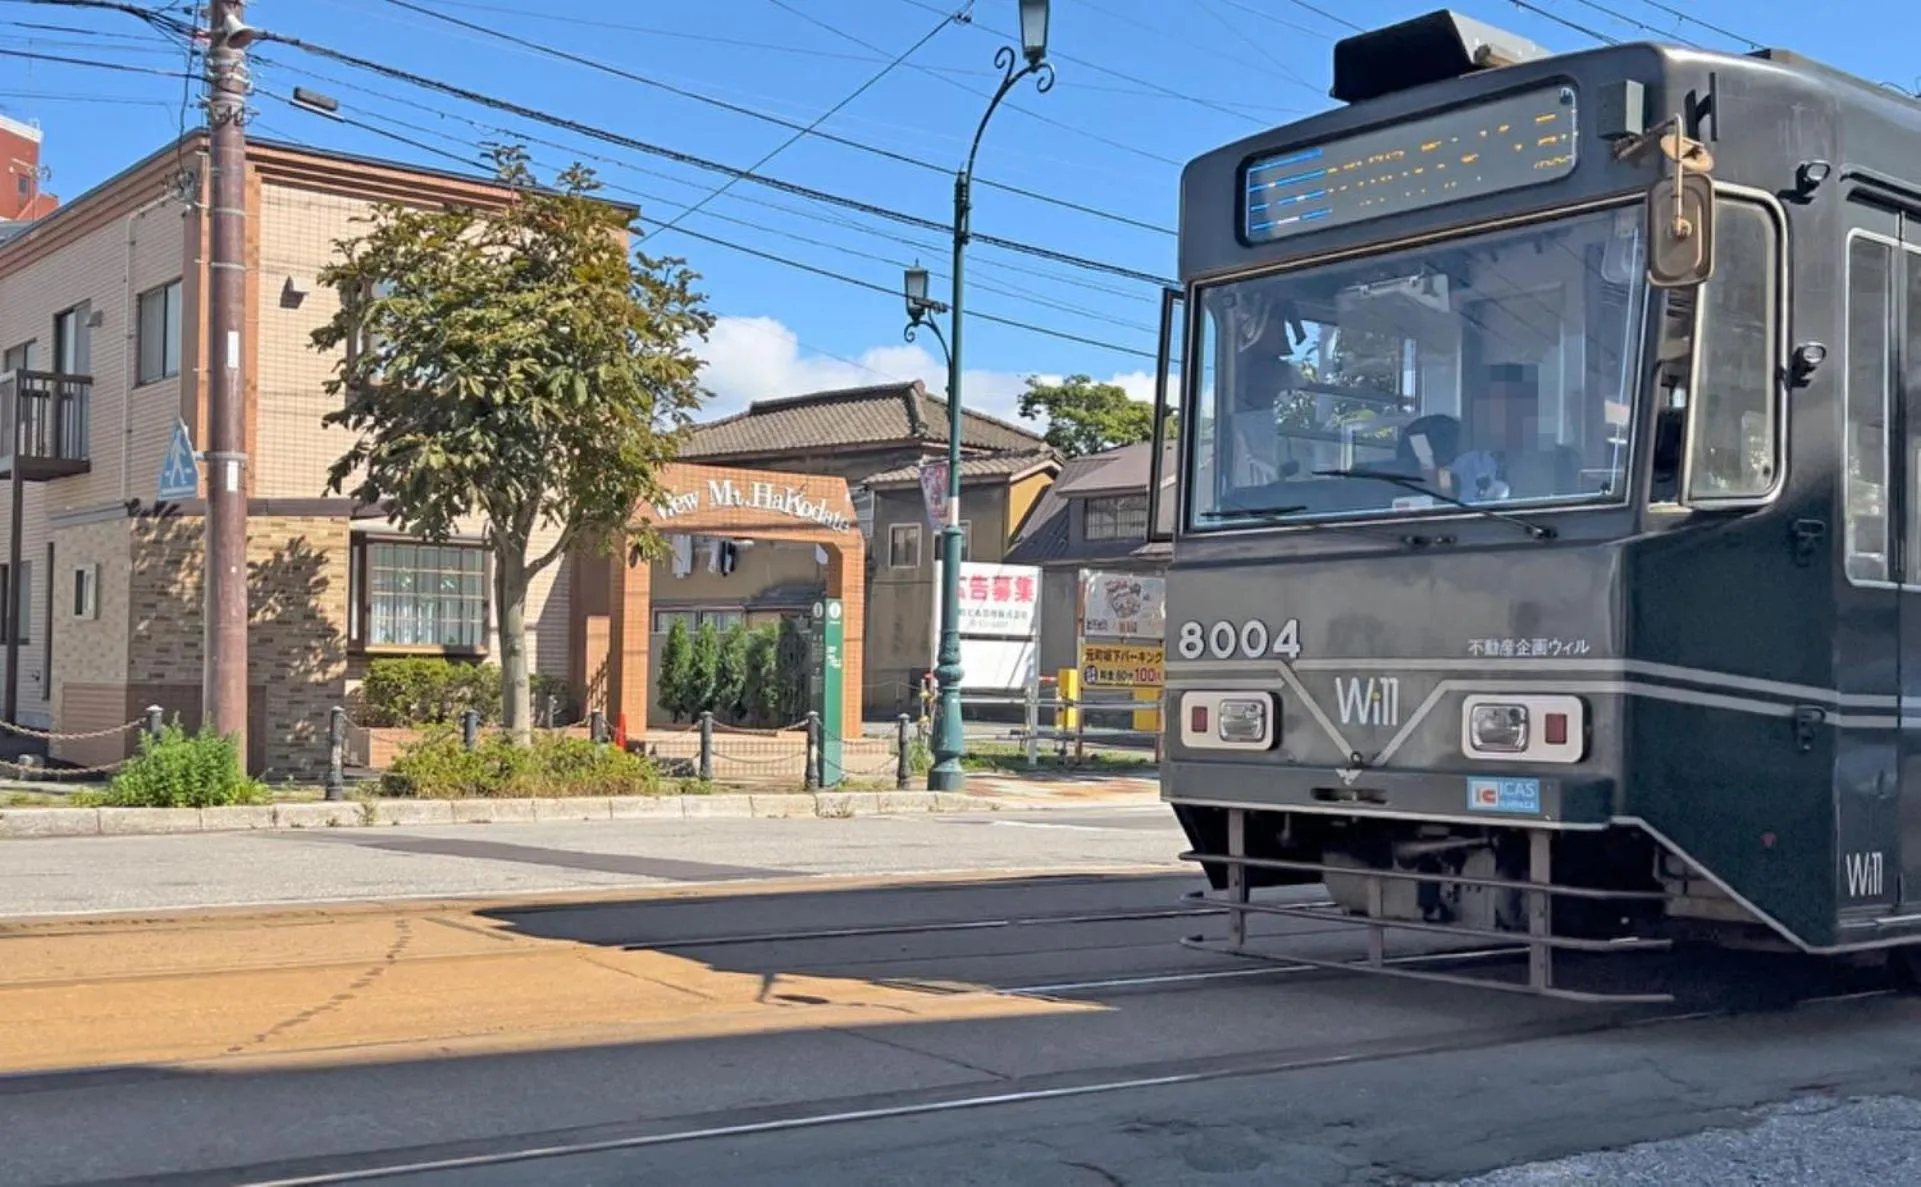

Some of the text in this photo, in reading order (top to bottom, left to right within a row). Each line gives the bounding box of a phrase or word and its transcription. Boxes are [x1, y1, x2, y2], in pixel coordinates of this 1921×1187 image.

[1179, 618, 1301, 660] 8004
[1467, 637, 1591, 657] 不動産企画ウィル
[1335, 676, 1399, 726] Will
[1845, 851, 1883, 897] Will
